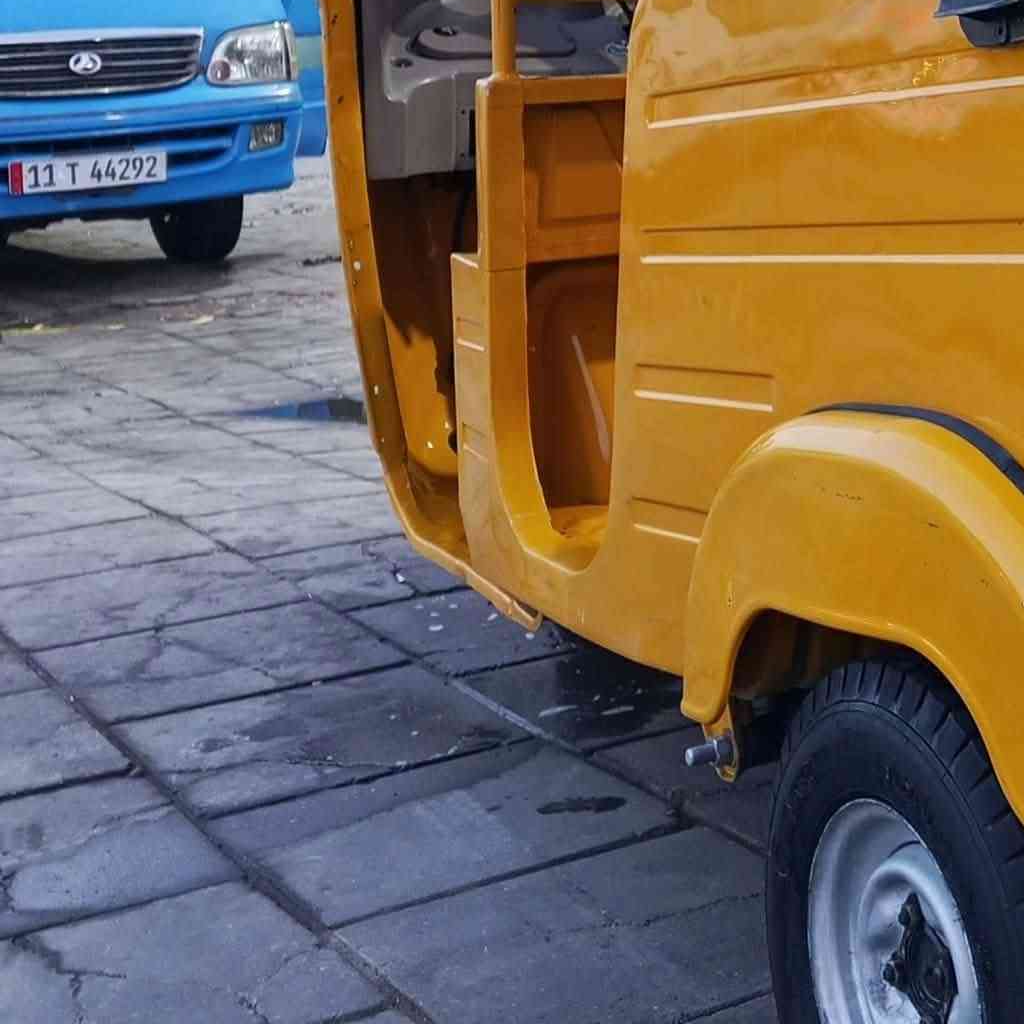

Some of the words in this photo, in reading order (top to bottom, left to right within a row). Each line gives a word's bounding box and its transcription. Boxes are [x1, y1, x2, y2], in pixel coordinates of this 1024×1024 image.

[28, 163, 56, 189] 11
[66, 161, 79, 185] T
[90, 155, 158, 183] 44292
